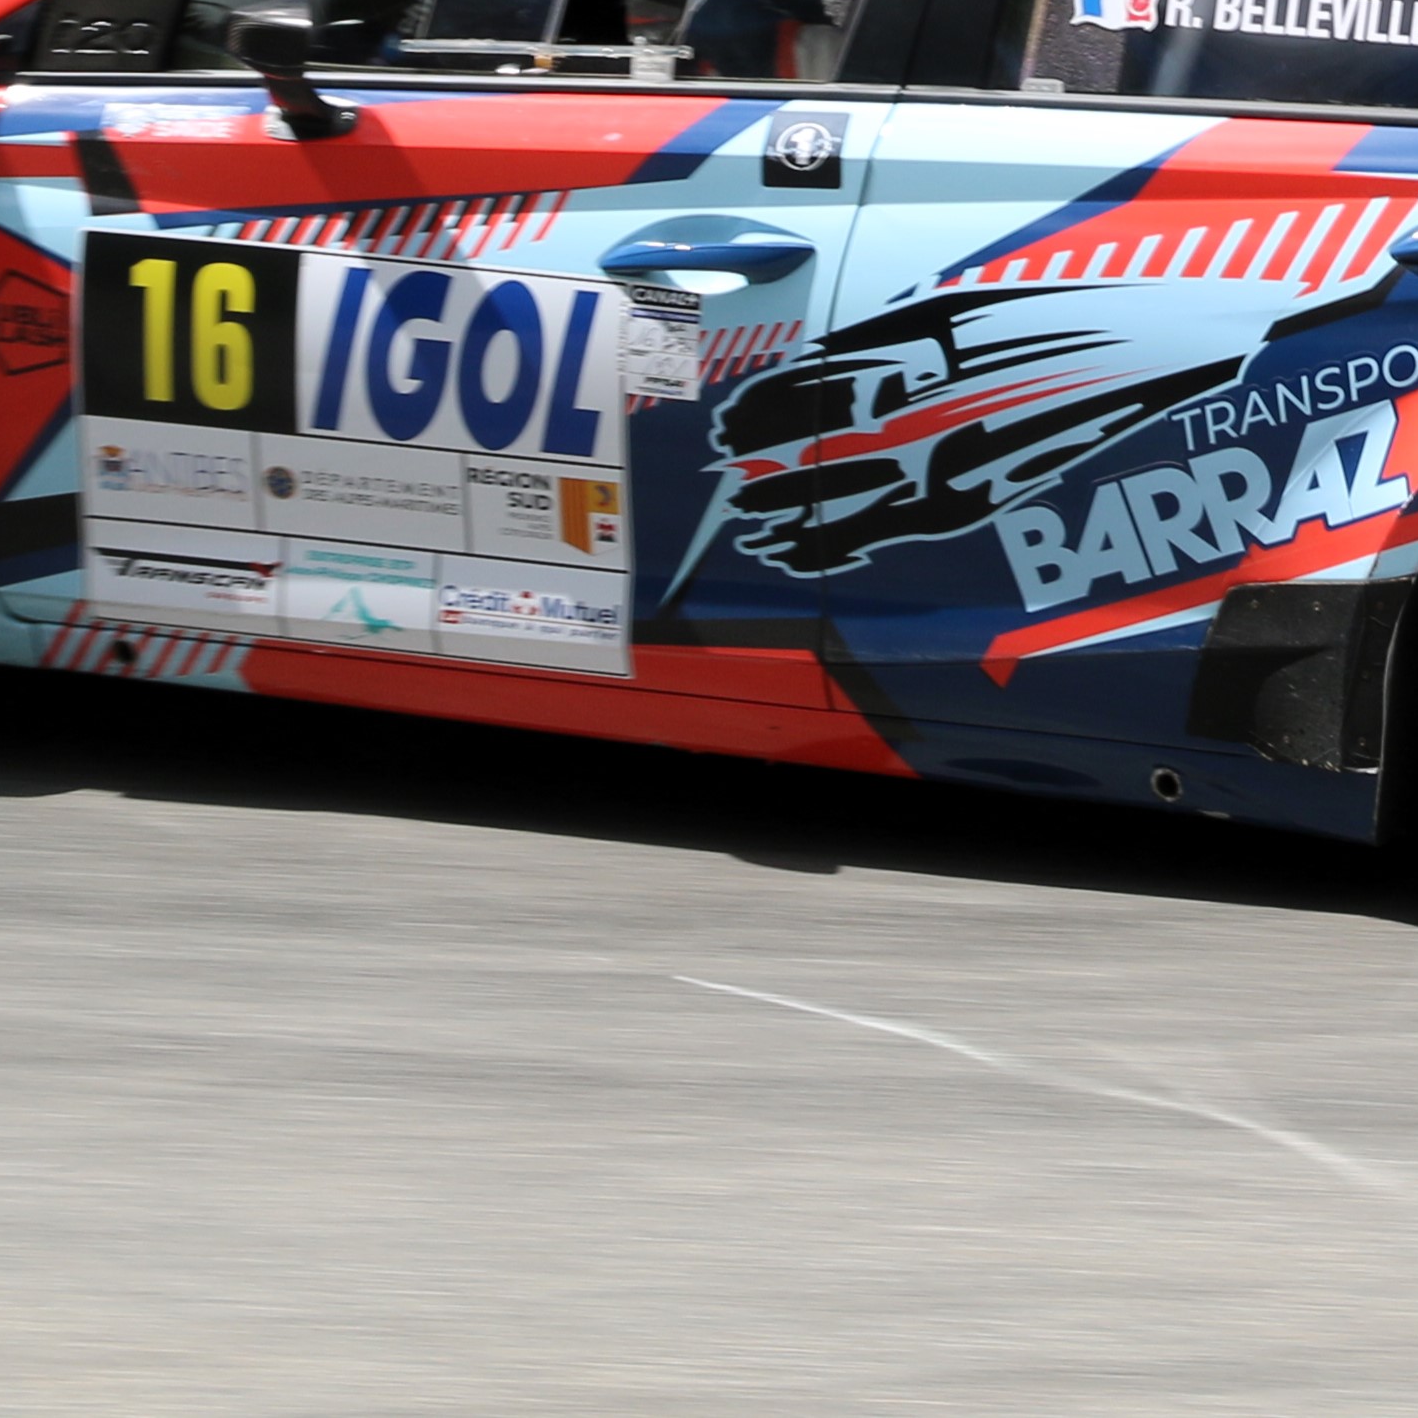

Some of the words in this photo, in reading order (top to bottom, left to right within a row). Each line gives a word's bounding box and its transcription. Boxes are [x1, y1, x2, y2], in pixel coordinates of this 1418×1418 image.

[129, 258, 256, 412] 16
[310, 266, 601, 459] IGOL
[506, 491, 551, 511] SUD
[991, 398, 1410, 613] BARRAZ
[541, 596, 621, 625] Mutuel
